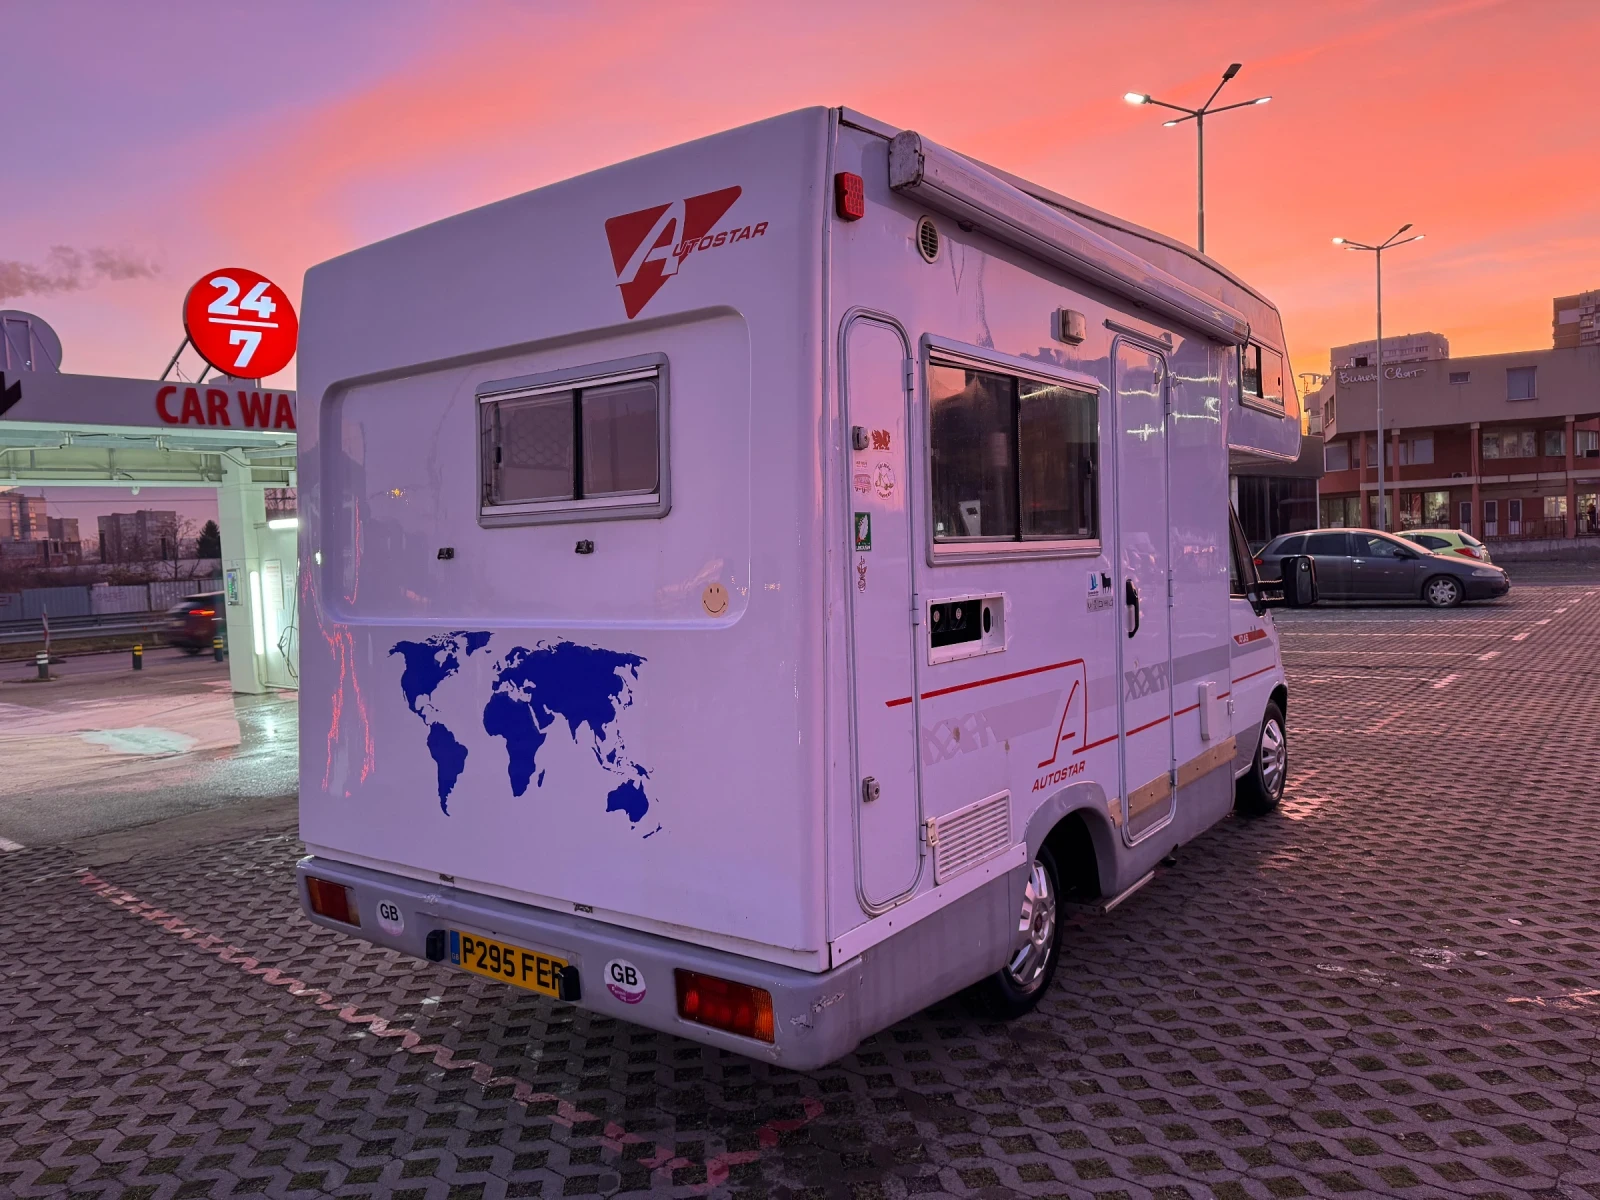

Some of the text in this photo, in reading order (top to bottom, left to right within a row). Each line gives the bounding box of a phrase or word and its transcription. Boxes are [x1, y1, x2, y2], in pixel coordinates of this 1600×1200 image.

[207, 276, 276, 318] 24
[229, 329, 262, 368] 7
[155, 385, 231, 427] CAR
[1031, 760, 1086, 793] AUTOSTAR
[380, 903, 399, 921] GB
[462, 935, 516, 978] P295
[611, 963, 638, 986] GB
